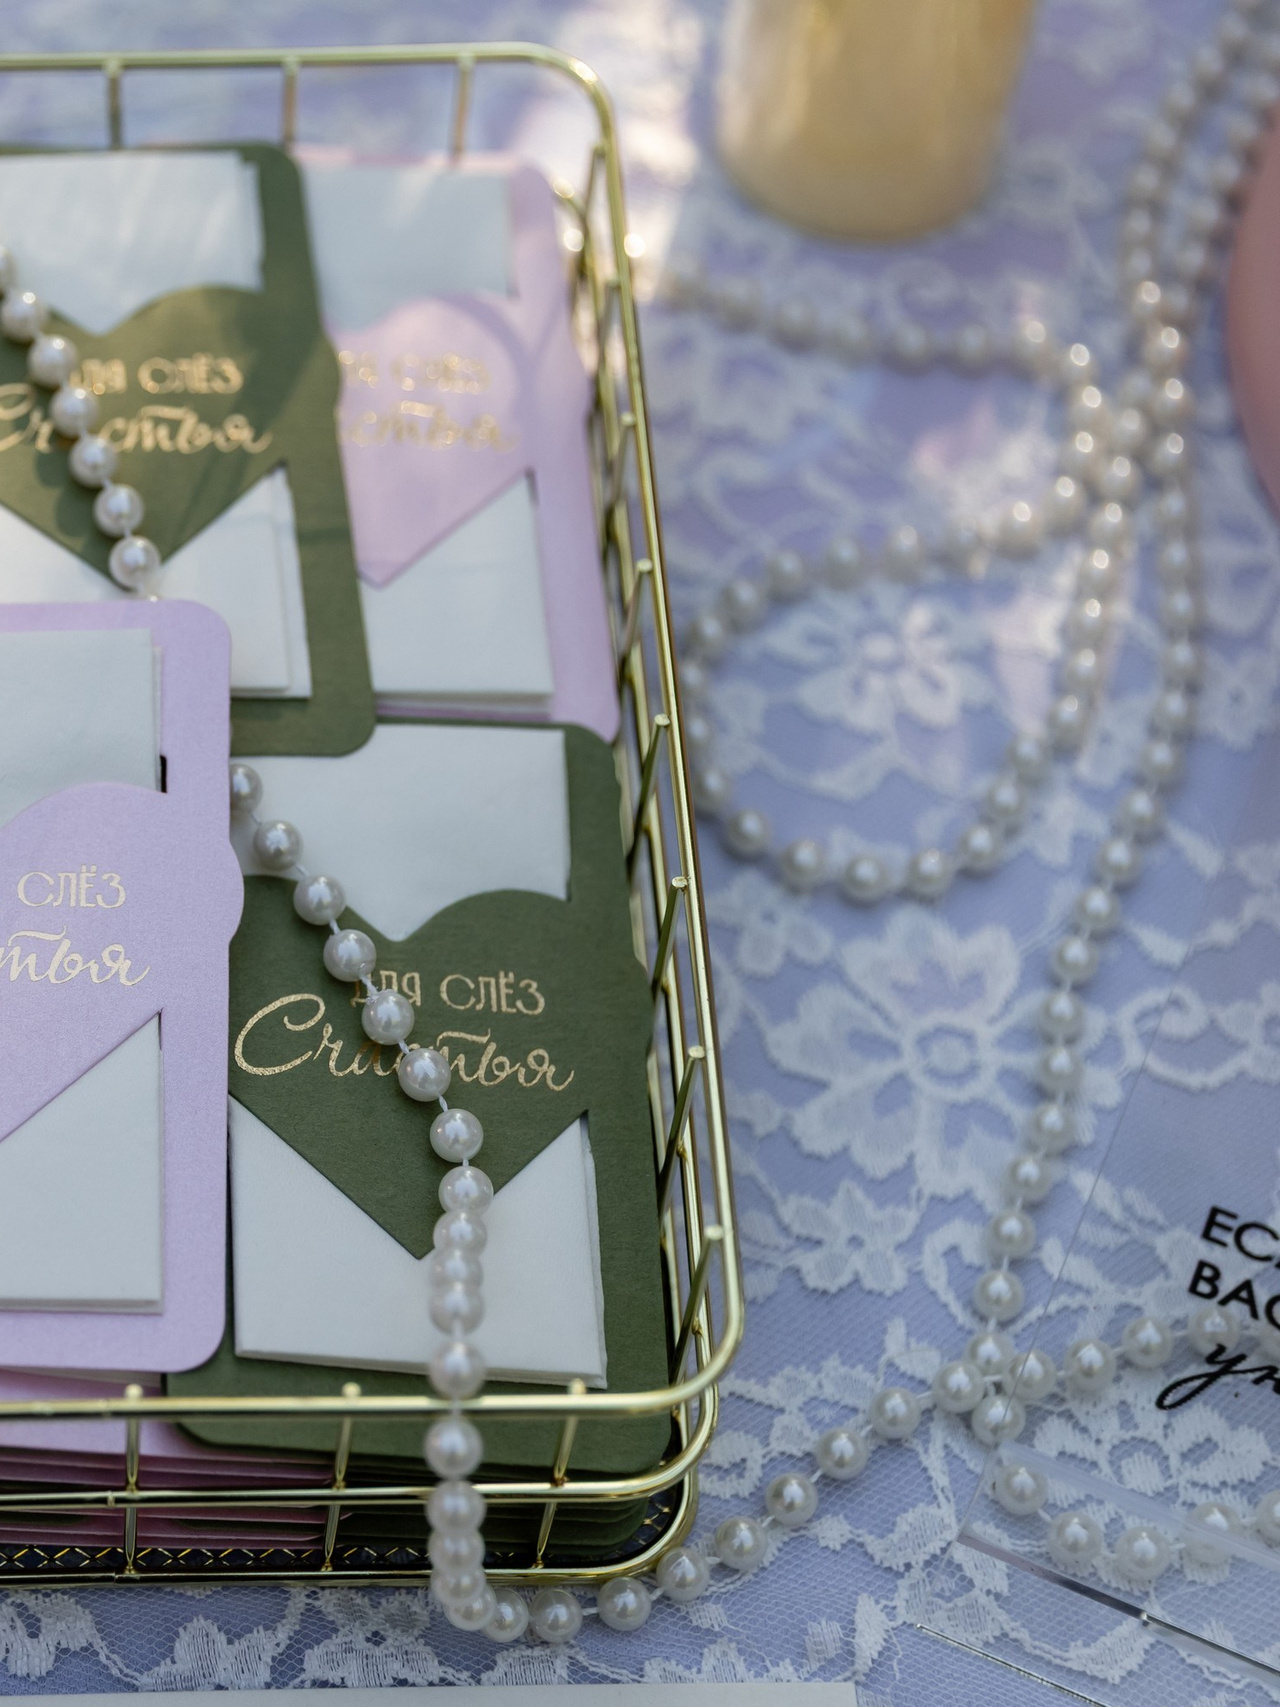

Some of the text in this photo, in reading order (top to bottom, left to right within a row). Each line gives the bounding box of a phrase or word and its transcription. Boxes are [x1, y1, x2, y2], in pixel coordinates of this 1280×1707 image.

[17, 864, 127, 909] СЛЁЗ
[439, 970, 546, 1016] СЛЁЗ
[1201, 1205, 1280, 1269] ЕС
